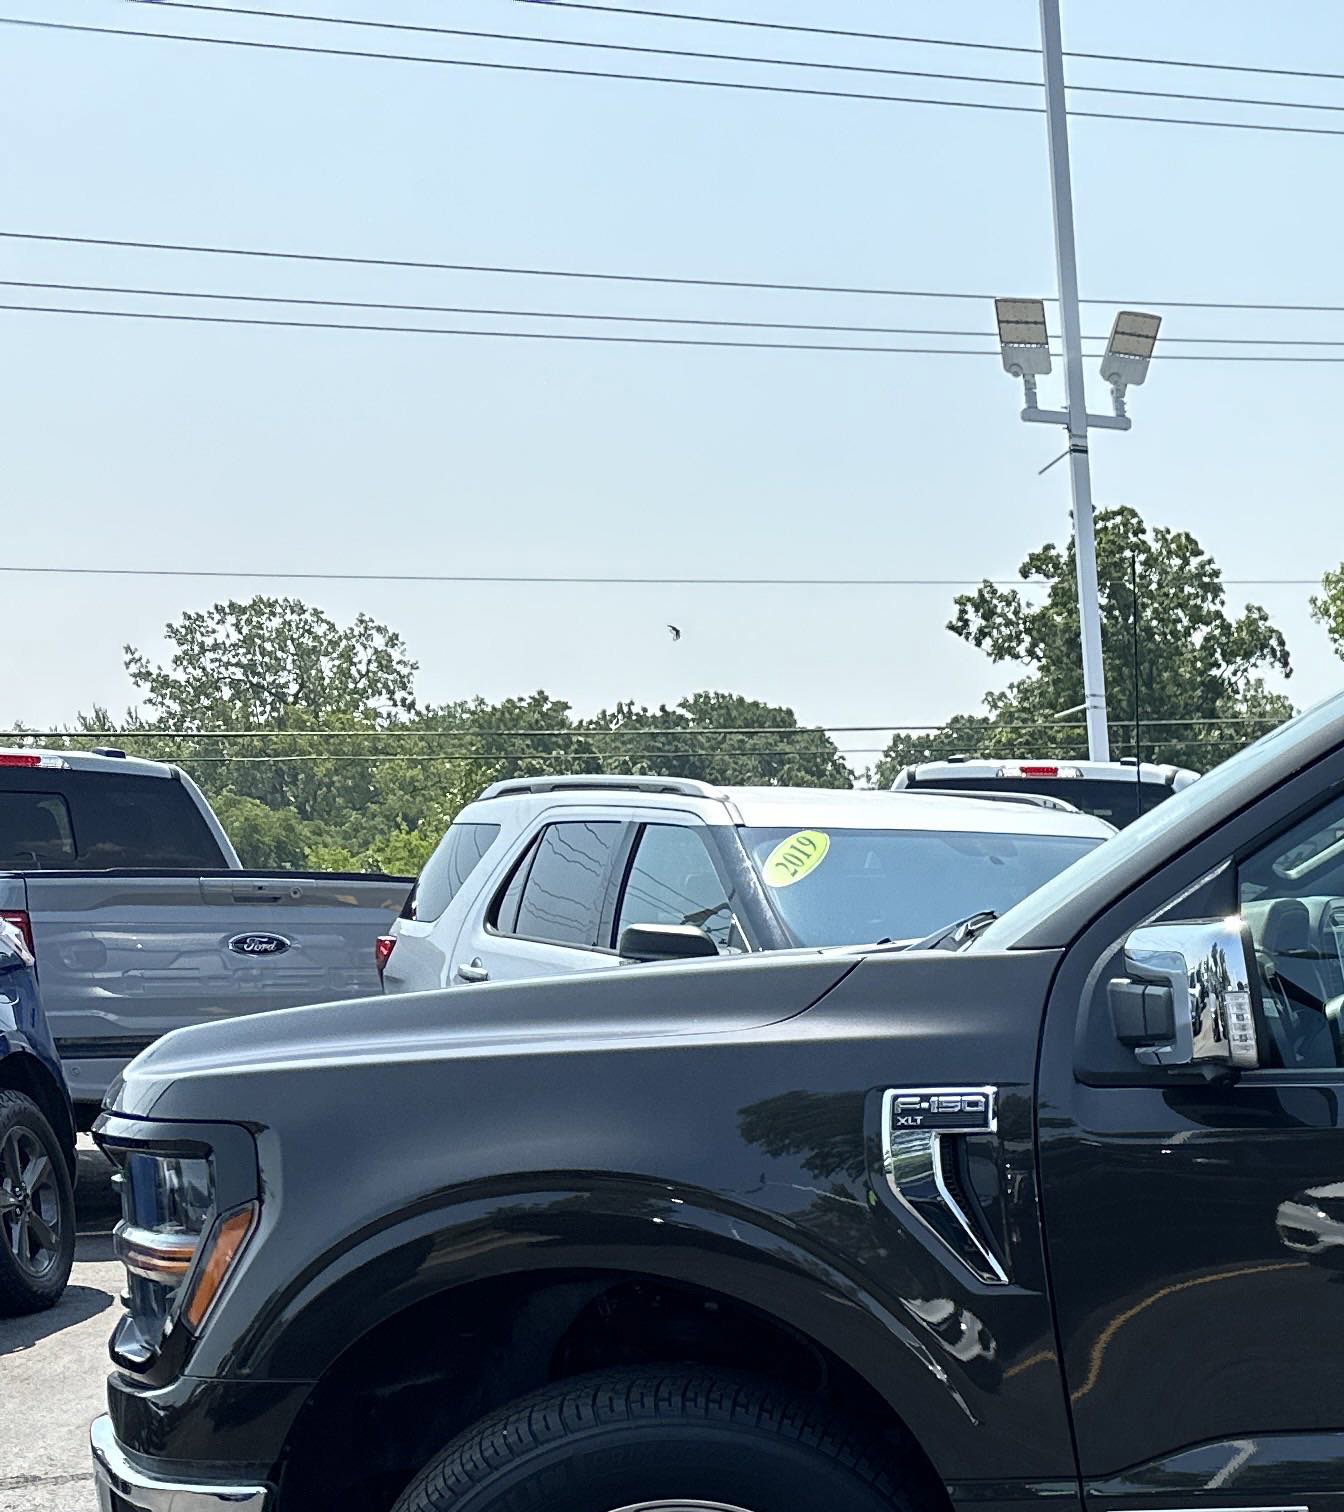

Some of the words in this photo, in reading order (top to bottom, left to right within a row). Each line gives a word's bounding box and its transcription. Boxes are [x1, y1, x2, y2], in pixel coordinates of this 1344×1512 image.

[775, 836, 817, 877] 2019
[243, 937, 277, 951] Ford
[894, 1096, 986, 1113] F-150
[896, 1116, 923, 1126] XLT
